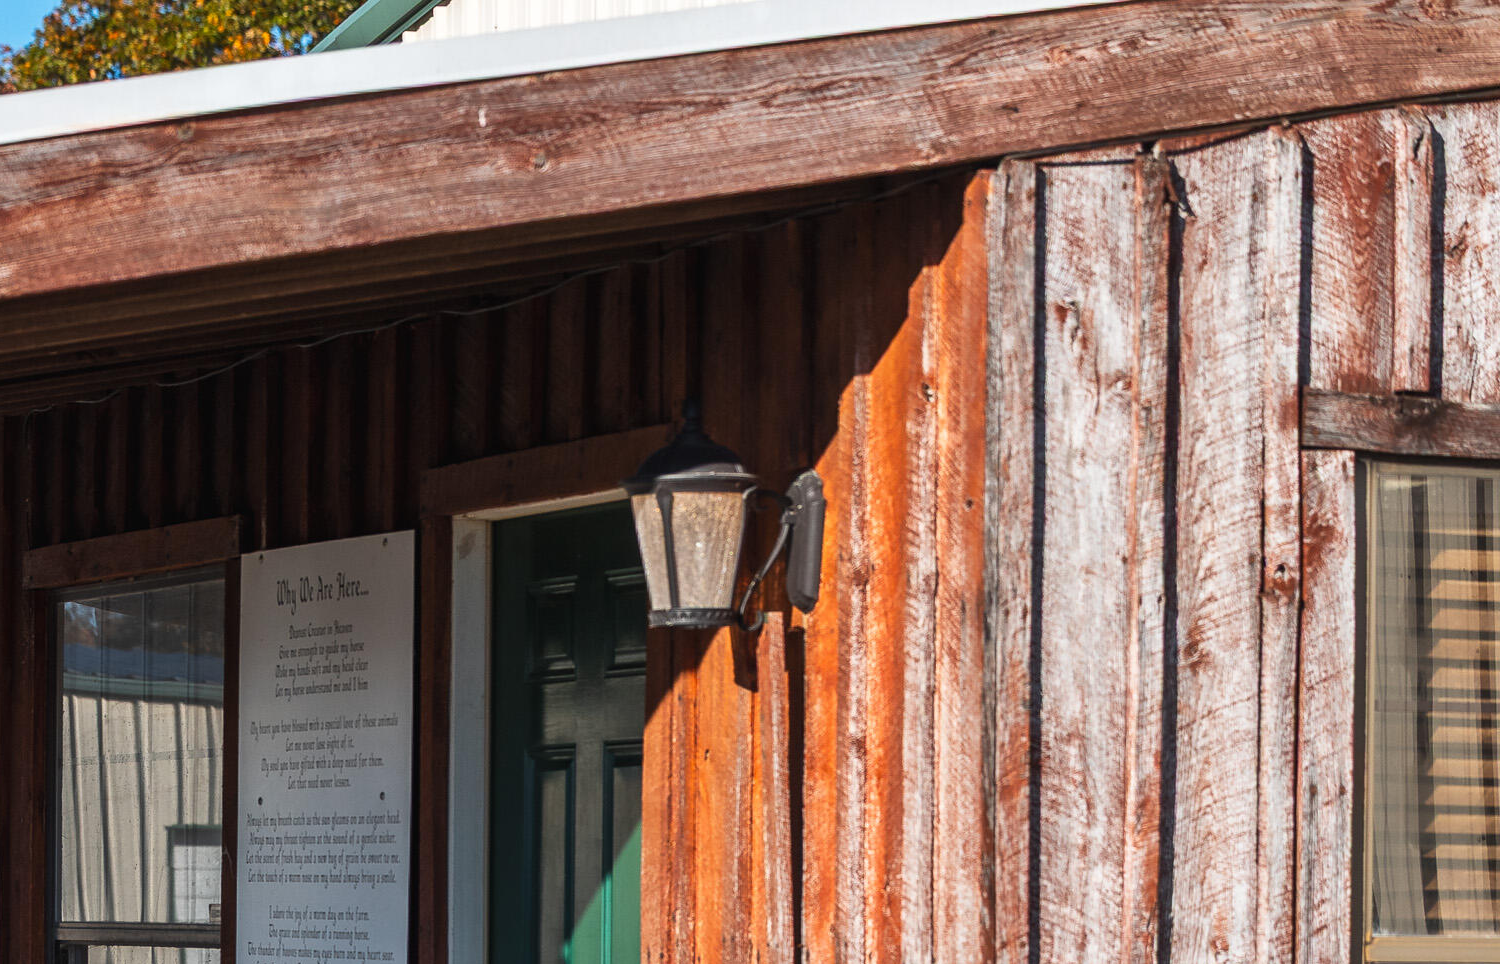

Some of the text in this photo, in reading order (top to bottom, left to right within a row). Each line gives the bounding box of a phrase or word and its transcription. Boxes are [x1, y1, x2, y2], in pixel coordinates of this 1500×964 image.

[277, 579, 297, 615] Why
[300, 577, 314, 603] We
[317, 576, 333, 601] Are
